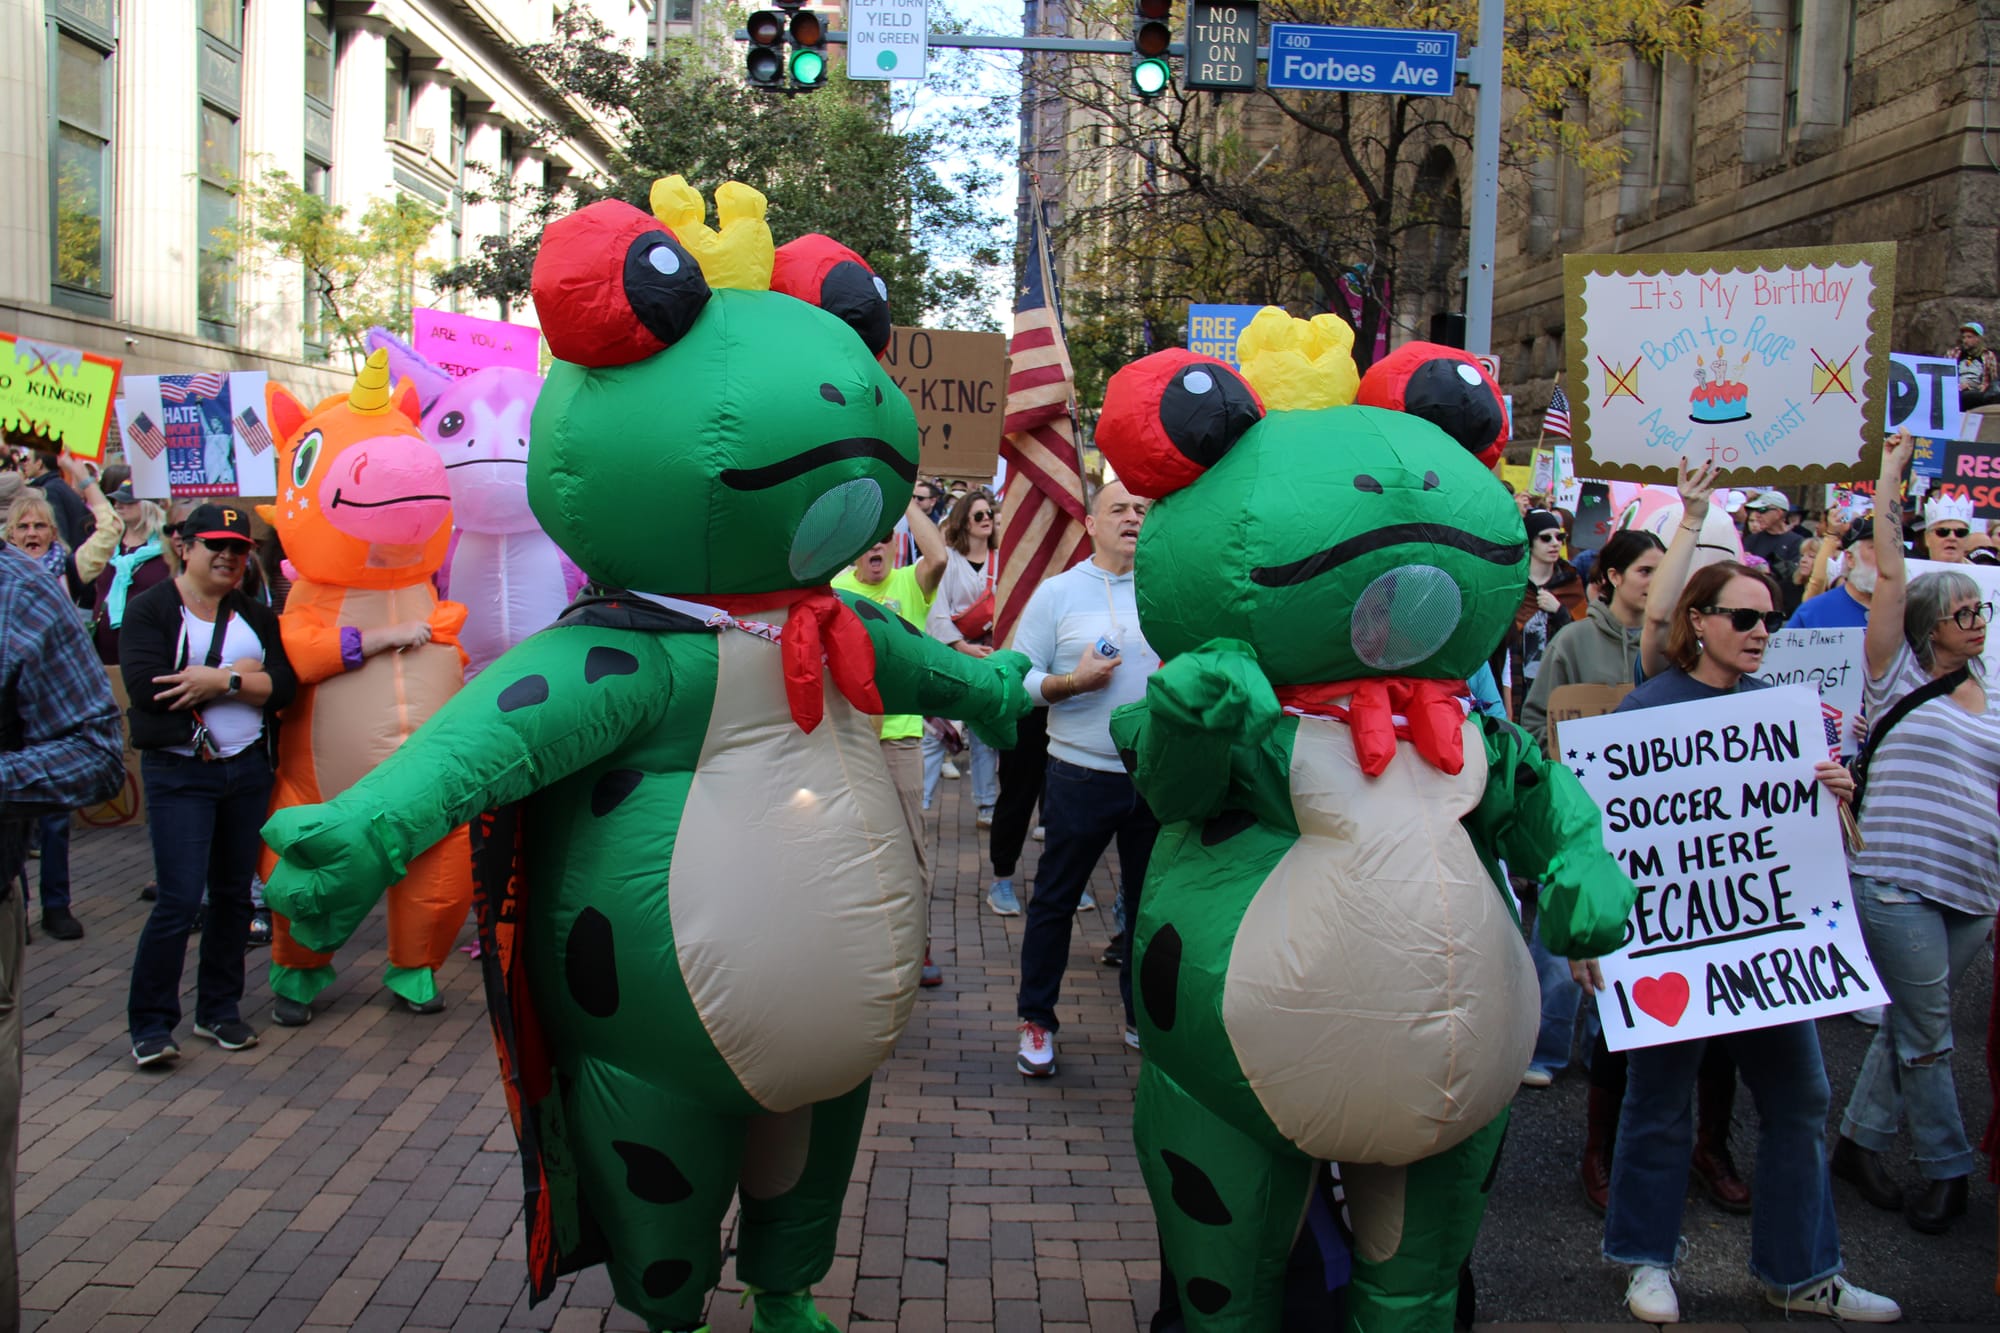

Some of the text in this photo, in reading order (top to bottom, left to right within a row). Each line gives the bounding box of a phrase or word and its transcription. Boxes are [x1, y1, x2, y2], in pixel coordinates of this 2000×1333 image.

[867, 12, 912, 27] YIELD
[1209, 7, 1237, 24] NO
[857, 31, 919, 44] ON GREEN
[1196, 25, 1250, 44] TURN
[1208, 45, 1236, 62] ON
[1285, 35, 1441, 55] 400 500
[1201, 64, 1242, 82] RED
[1284, 55, 1439, 86] Forbes Ave
[1628, 269, 1853, 320] It's My Birthday
[431, 326, 457, 342] ARE
[470, 332, 497, 349] YOU
[1191, 316, 1236, 339] FREE
[1640, 315, 1796, 371] Born to Rage
[27, 381, 93, 409] KINGS!
[163, 406, 199, 424] HATE
[1638, 398, 1806, 463] Aged to Resist
[166, 436, 201, 448] MAKE
[169, 449, 202, 469] US
[170, 470, 207, 485] GREAT
[224, 510, 238, 526] P
[1603, 720, 1800, 780] SUBURBAN
[1606, 779, 1819, 832] SOCCER MOM
[1609, 825, 1778, 880] 'M HERE
[1613, 942, 1870, 1028] I AMERICA
